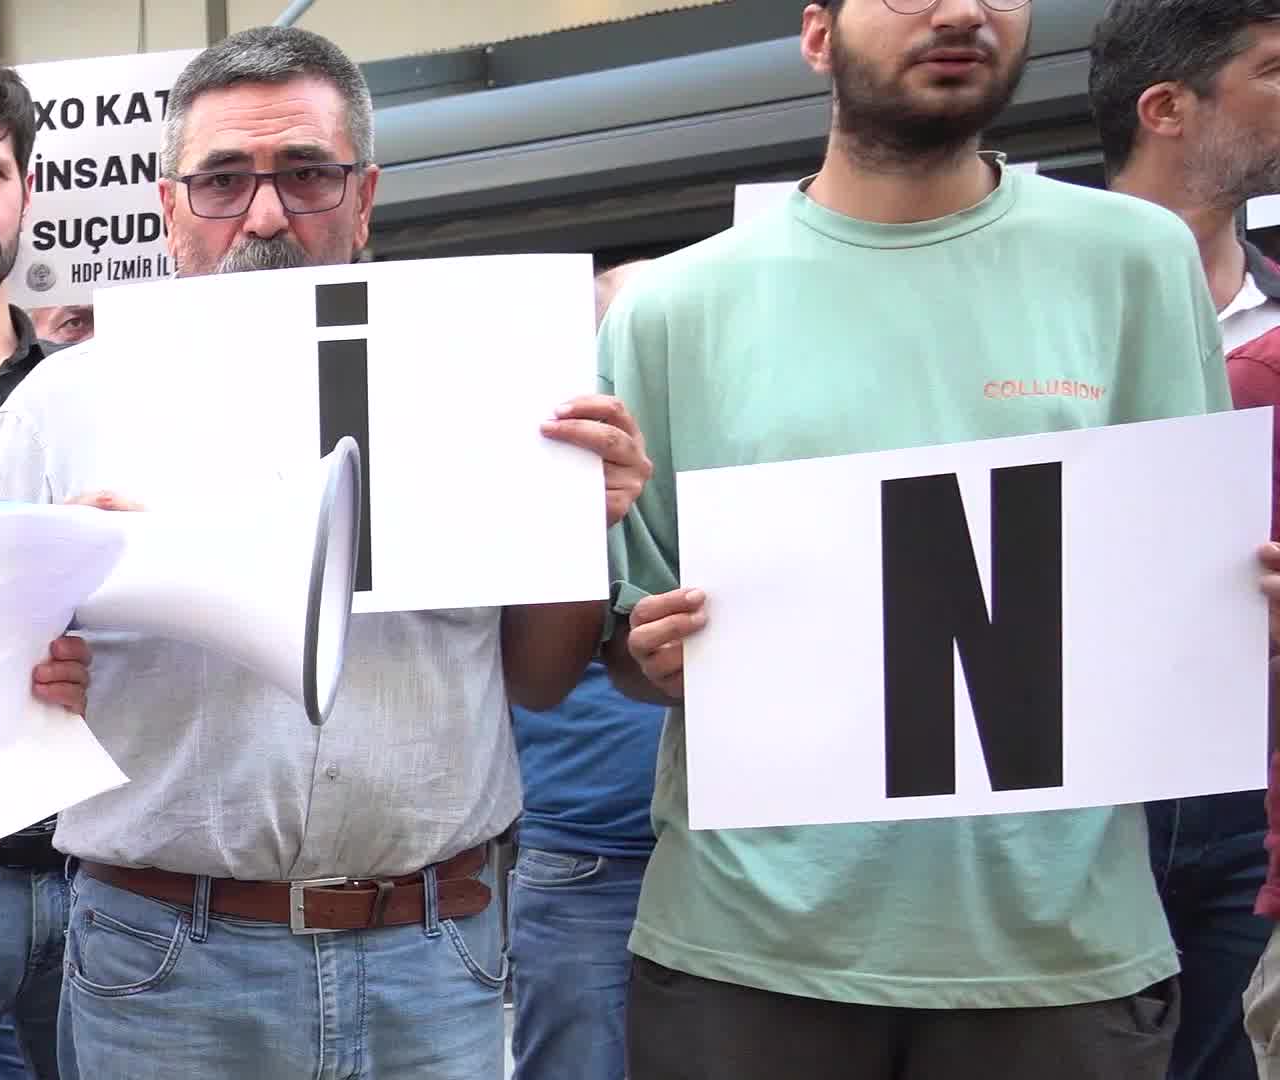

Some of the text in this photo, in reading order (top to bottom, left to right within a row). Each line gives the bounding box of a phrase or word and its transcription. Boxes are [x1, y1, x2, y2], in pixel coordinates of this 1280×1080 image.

[35, 153, 162, 193] İNSAN
[32, 212, 168, 254] SUÇUD
[71, 253, 171, 283] HDP İZMİR İL
[881, 461, 1064, 799] N
